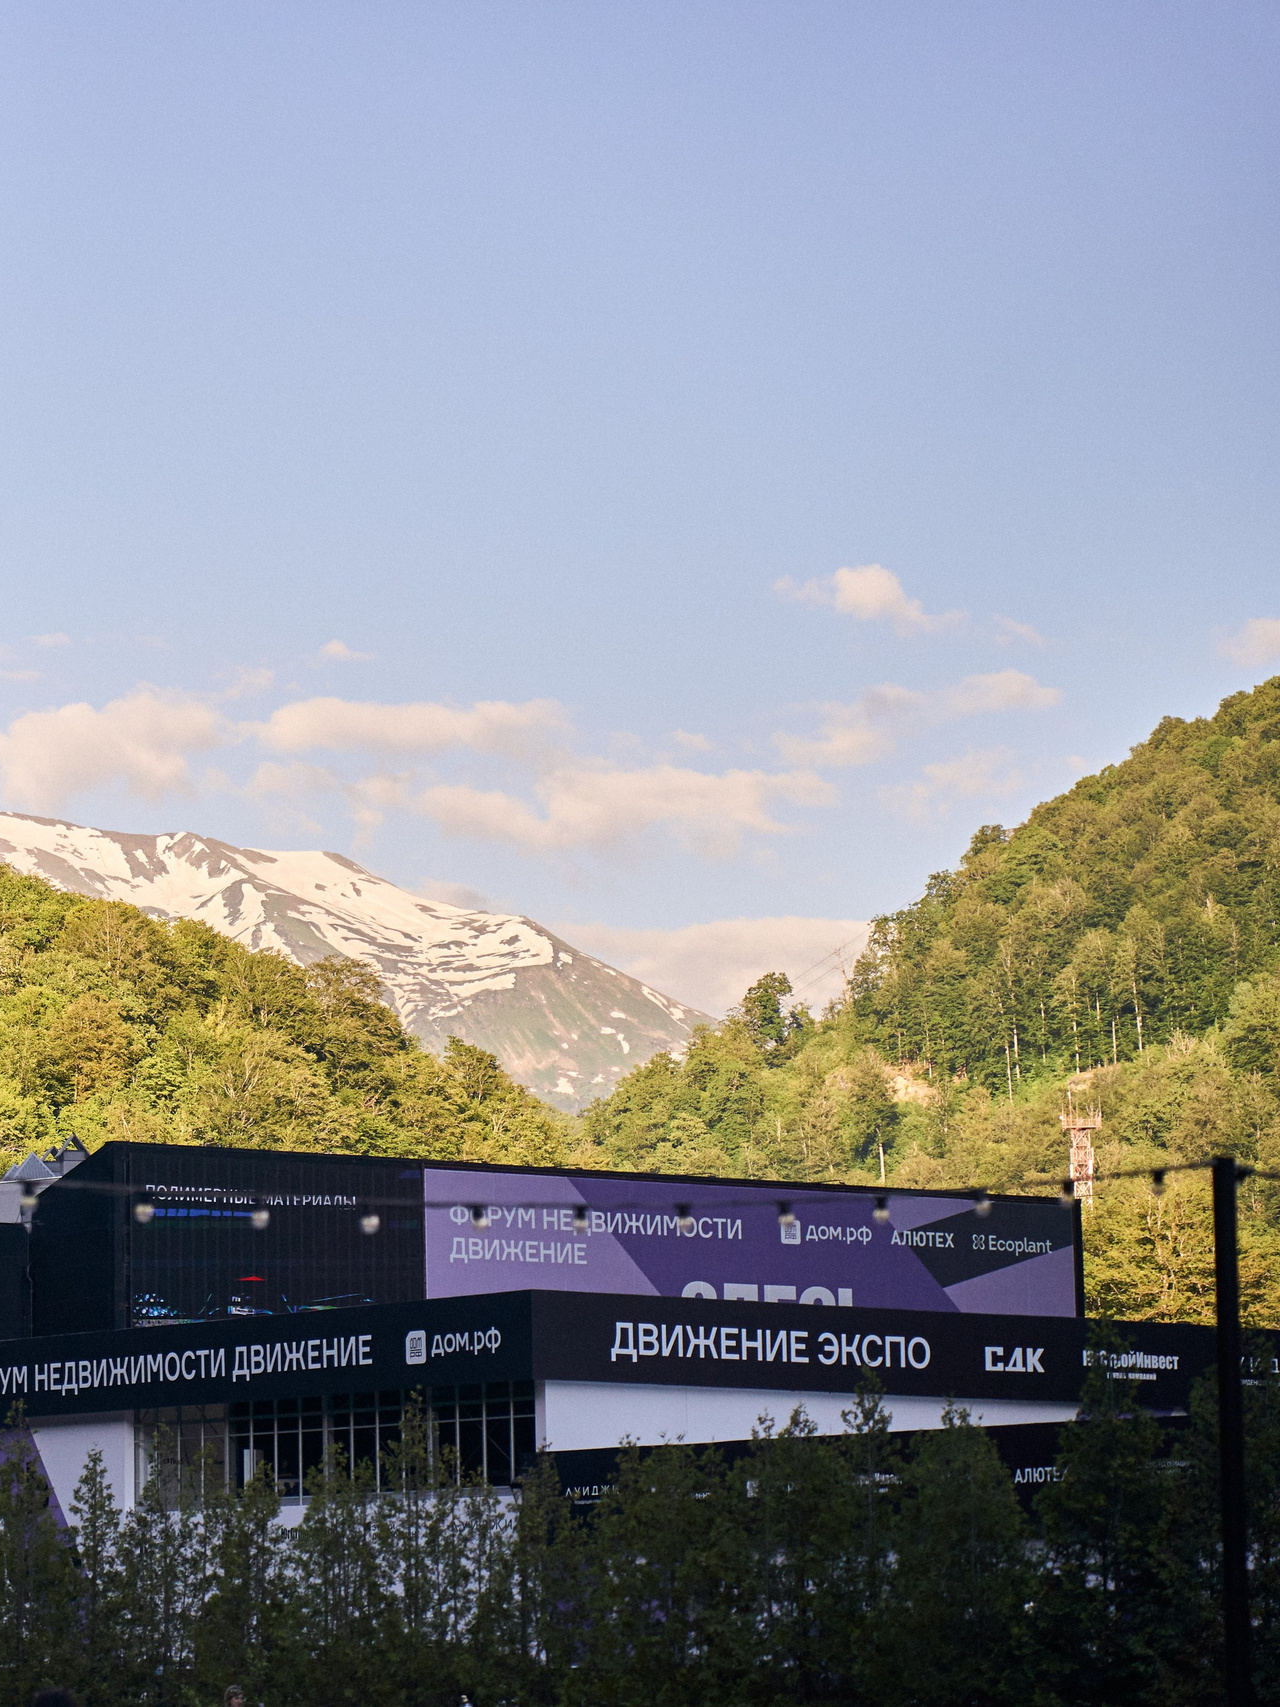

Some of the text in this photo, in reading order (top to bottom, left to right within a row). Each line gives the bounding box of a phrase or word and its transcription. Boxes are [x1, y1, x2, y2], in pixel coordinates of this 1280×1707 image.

[449, 1236, 588, 1265] ДВИЖЕНИЕ
[890, 1229, 955, 1248] АЛЮТЕХ
[988, 1235, 1052, 1256] Ecoplant
[610, 1321, 932, 1370] ДВИЖЕНИЕ ЭКСПО
[34, 1348, 226, 1395] НЕДВИЖИМОСТИ
[231, 1334, 373, 1382] ДВИЖЕНИЕ
